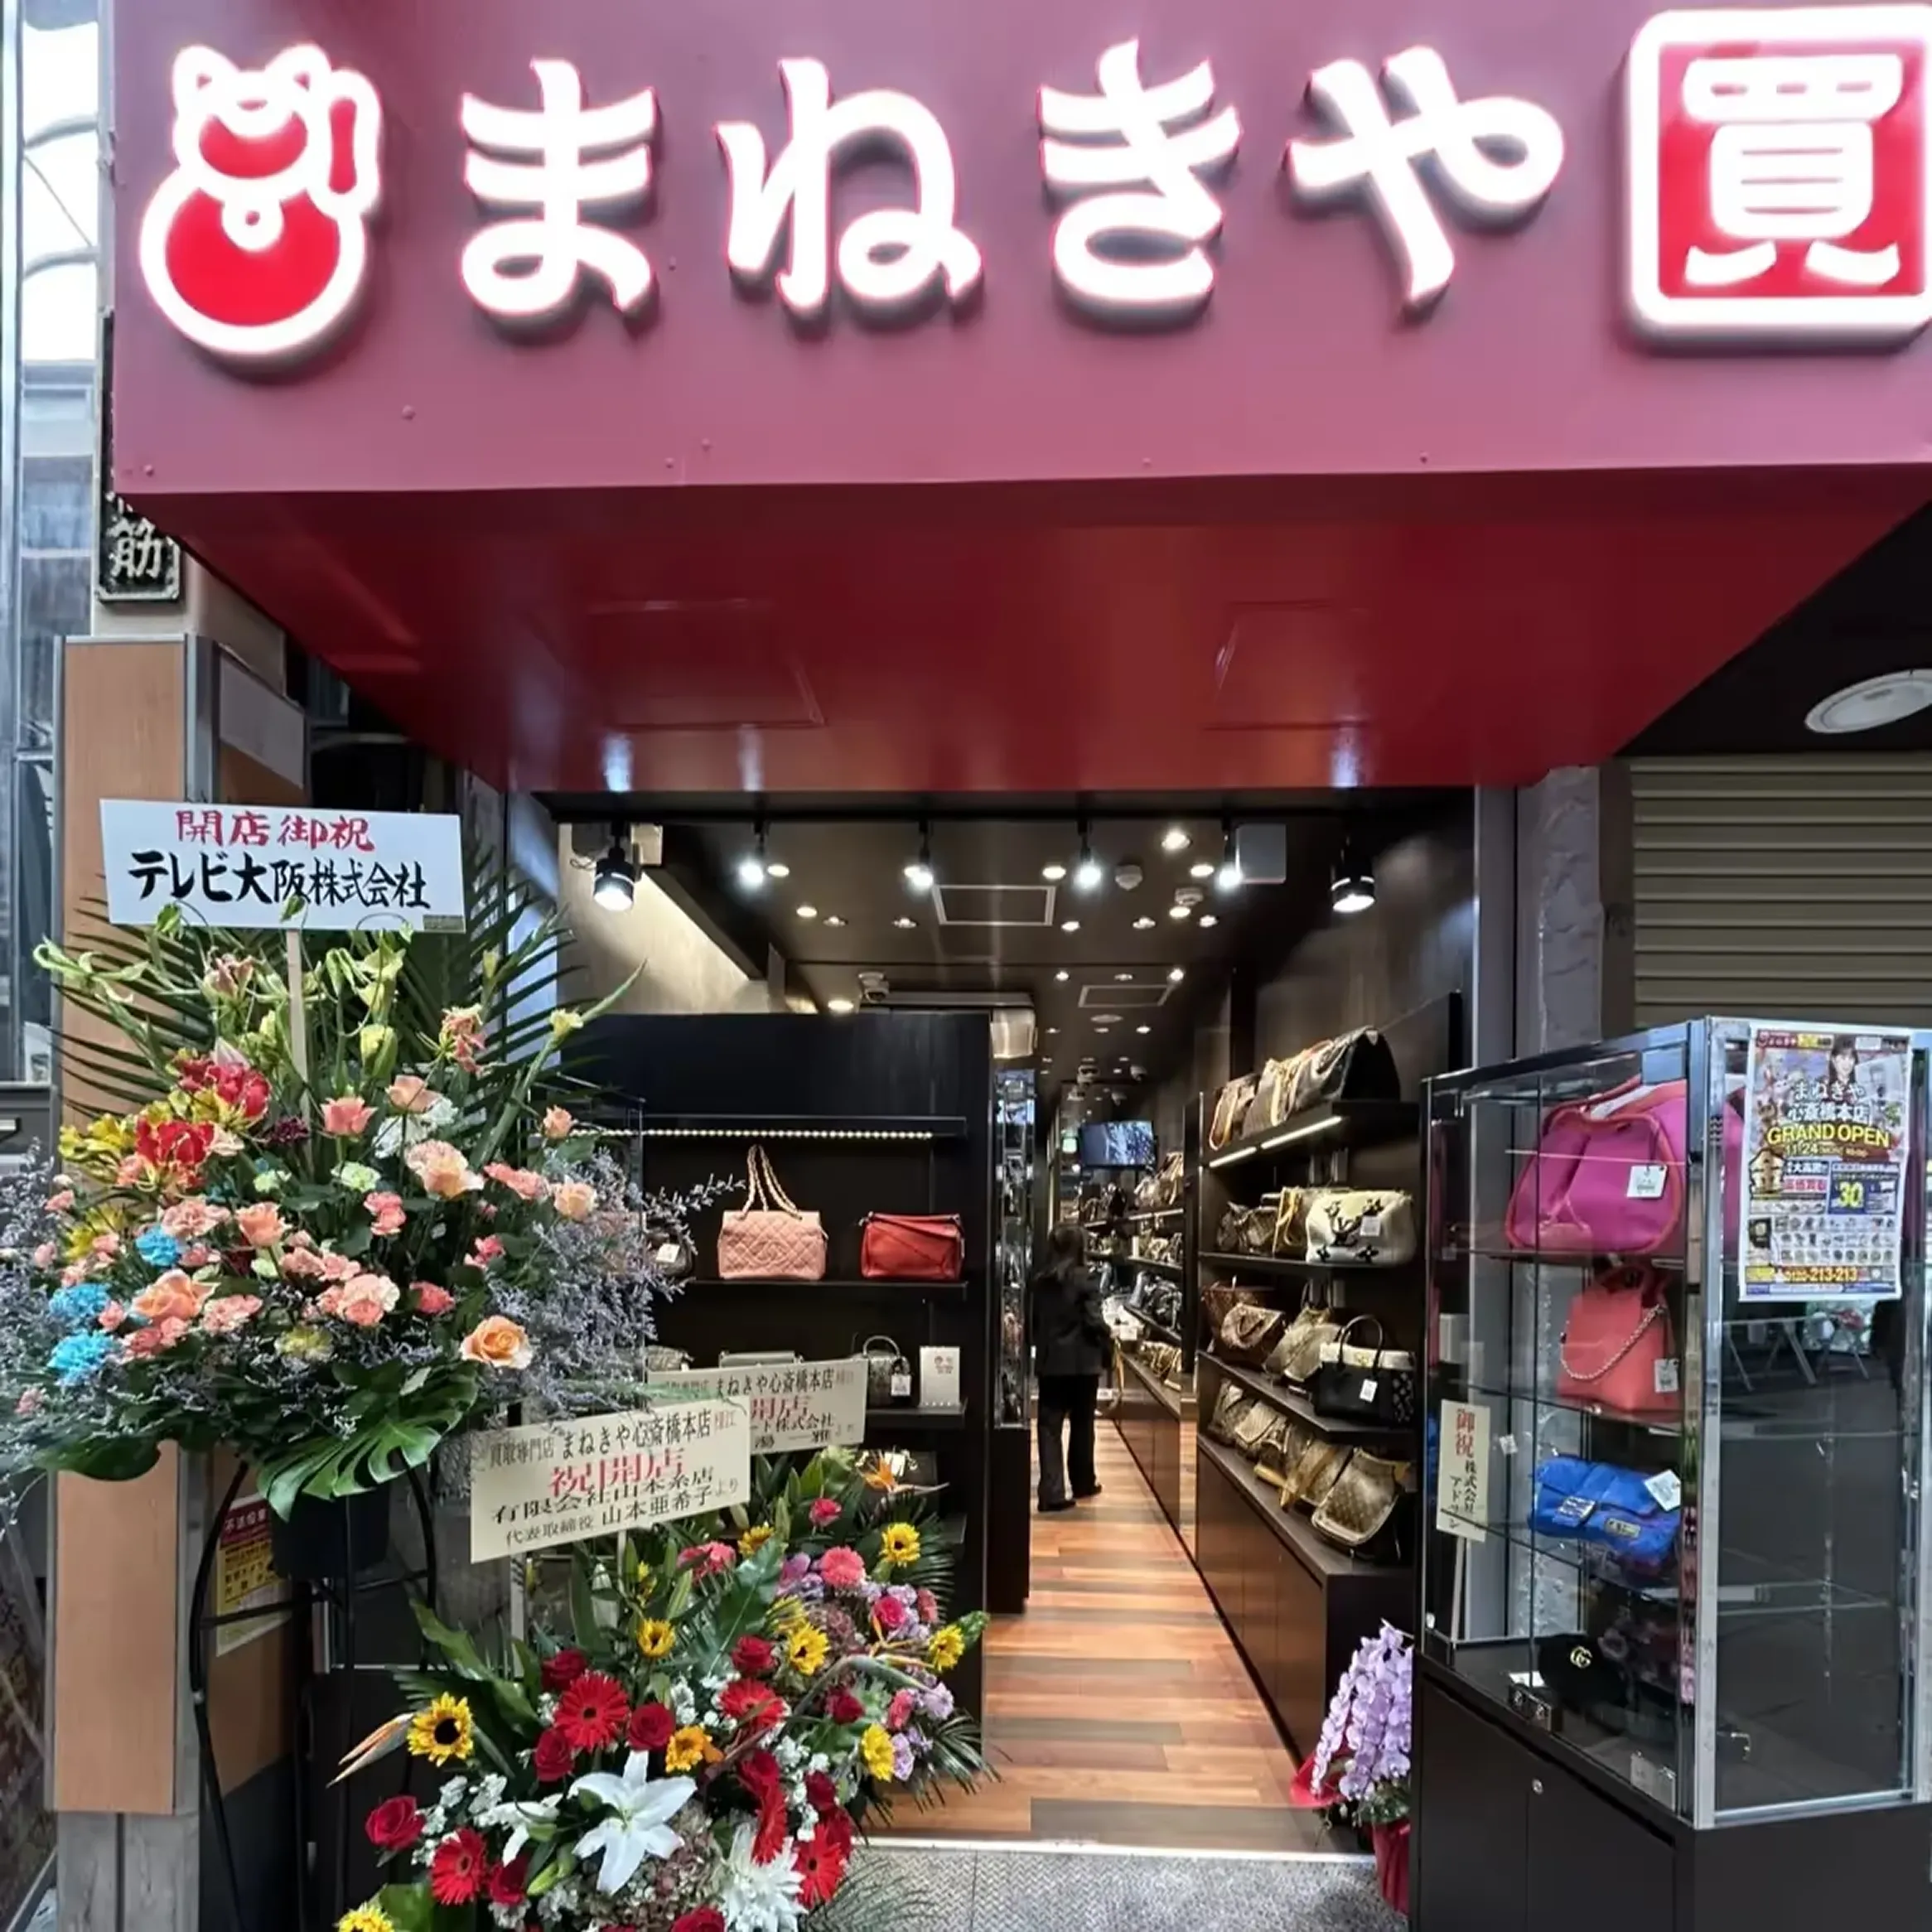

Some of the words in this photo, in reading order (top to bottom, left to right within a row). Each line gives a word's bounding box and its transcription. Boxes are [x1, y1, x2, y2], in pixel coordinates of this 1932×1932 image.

[460, 38, 1566, 315] まねきや
[1681, 53, 1903, 287] 買
[105, 517, 164, 578] 筋
[176, 810, 375, 852] 開店御祝
[128, 851, 432, 909] テレビ大阪株式会社
[1766, 1123, 1835, 1146] GRAND
[1837, 1123, 1890, 1148] OPEN
[716, 1368, 834, 1397] まねきや心斎橋本店
[562, 1408, 712, 1461] まねきや心斎橋本店
[601, 1487, 712, 1526] 山本亜希子
